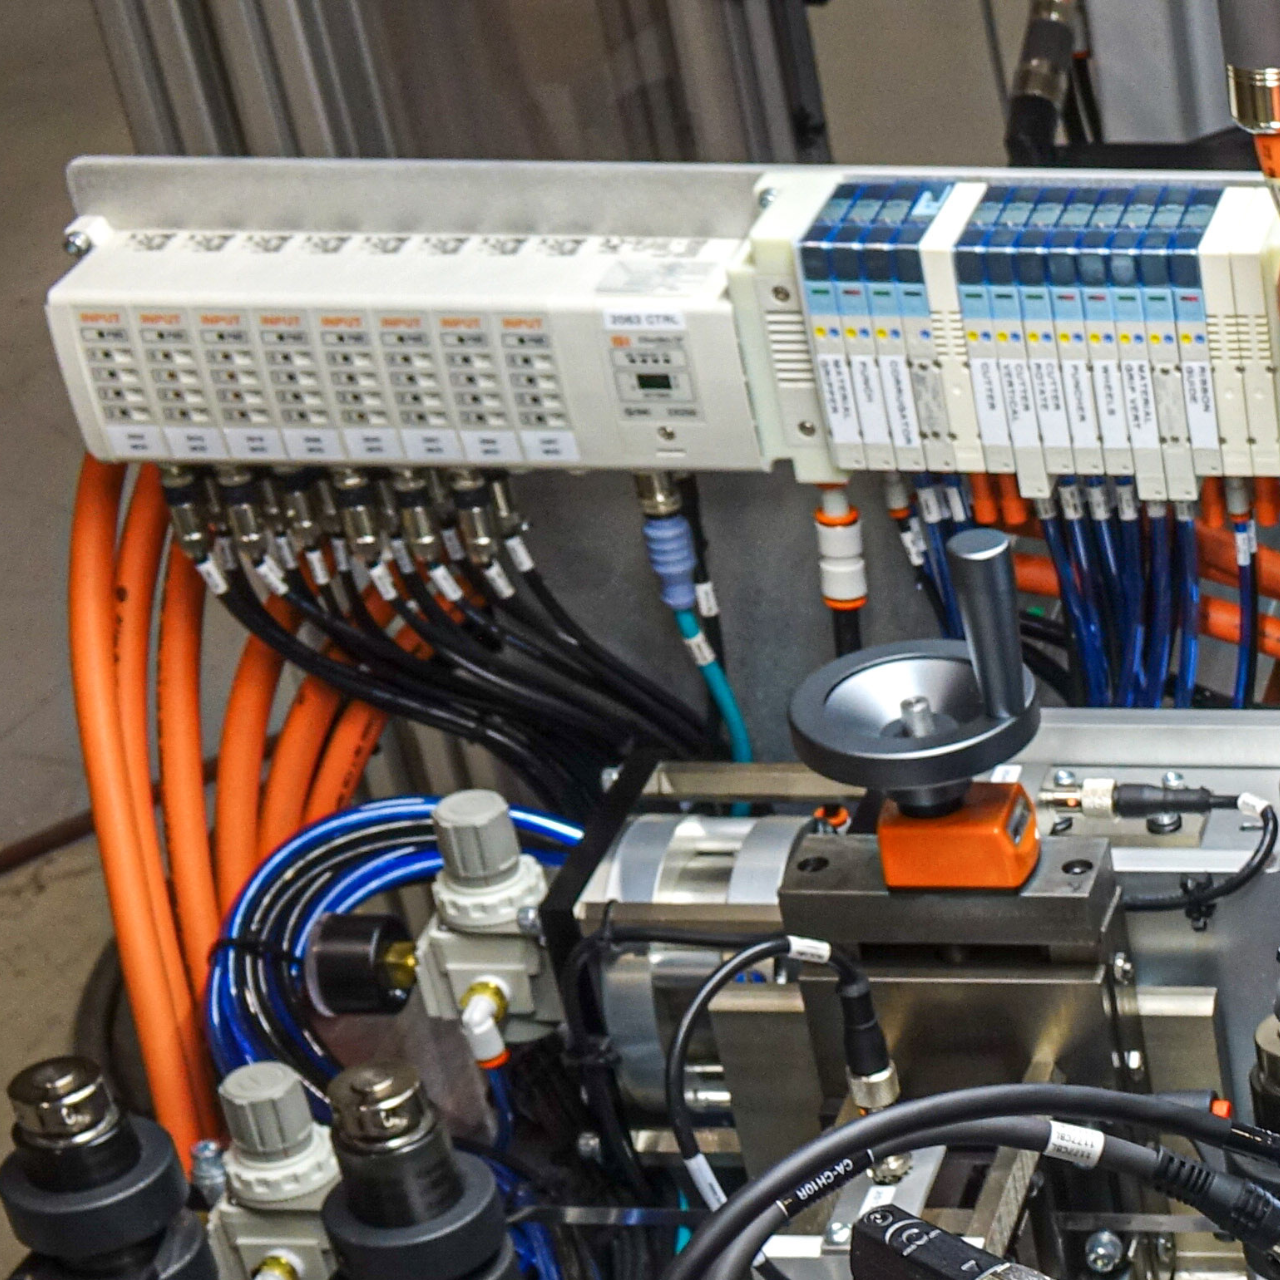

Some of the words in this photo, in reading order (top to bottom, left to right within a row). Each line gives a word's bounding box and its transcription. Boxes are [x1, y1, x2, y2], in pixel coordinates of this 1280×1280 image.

[833, 360, 851, 419] MATERIAL
[860, 361, 874, 403] PUNCH
[889, 360, 912, 445] CORRUGATOR
[981, 362, 996, 410] CUTTER
[1003, 363, 1019, 421] VERTICAL
[1015, 363, 1030, 411] CUTTER
[1034, 362, 1049, 411] ROTATE
[1045, 363, 1061, 411] CUTTER
[1071, 364, 1086, 422] PUNCHER
[1102, 365, 1116, 416] WHEELS
[1138, 364, 1151, 424] MATERIAL
[1185, 365, 1198, 404] GUIDE
[1199, 365, 1211, 413] RIBBON
[1130, 398, 1141, 429] VERT
[796, 1157, 854, 1201] CA-CH10R
